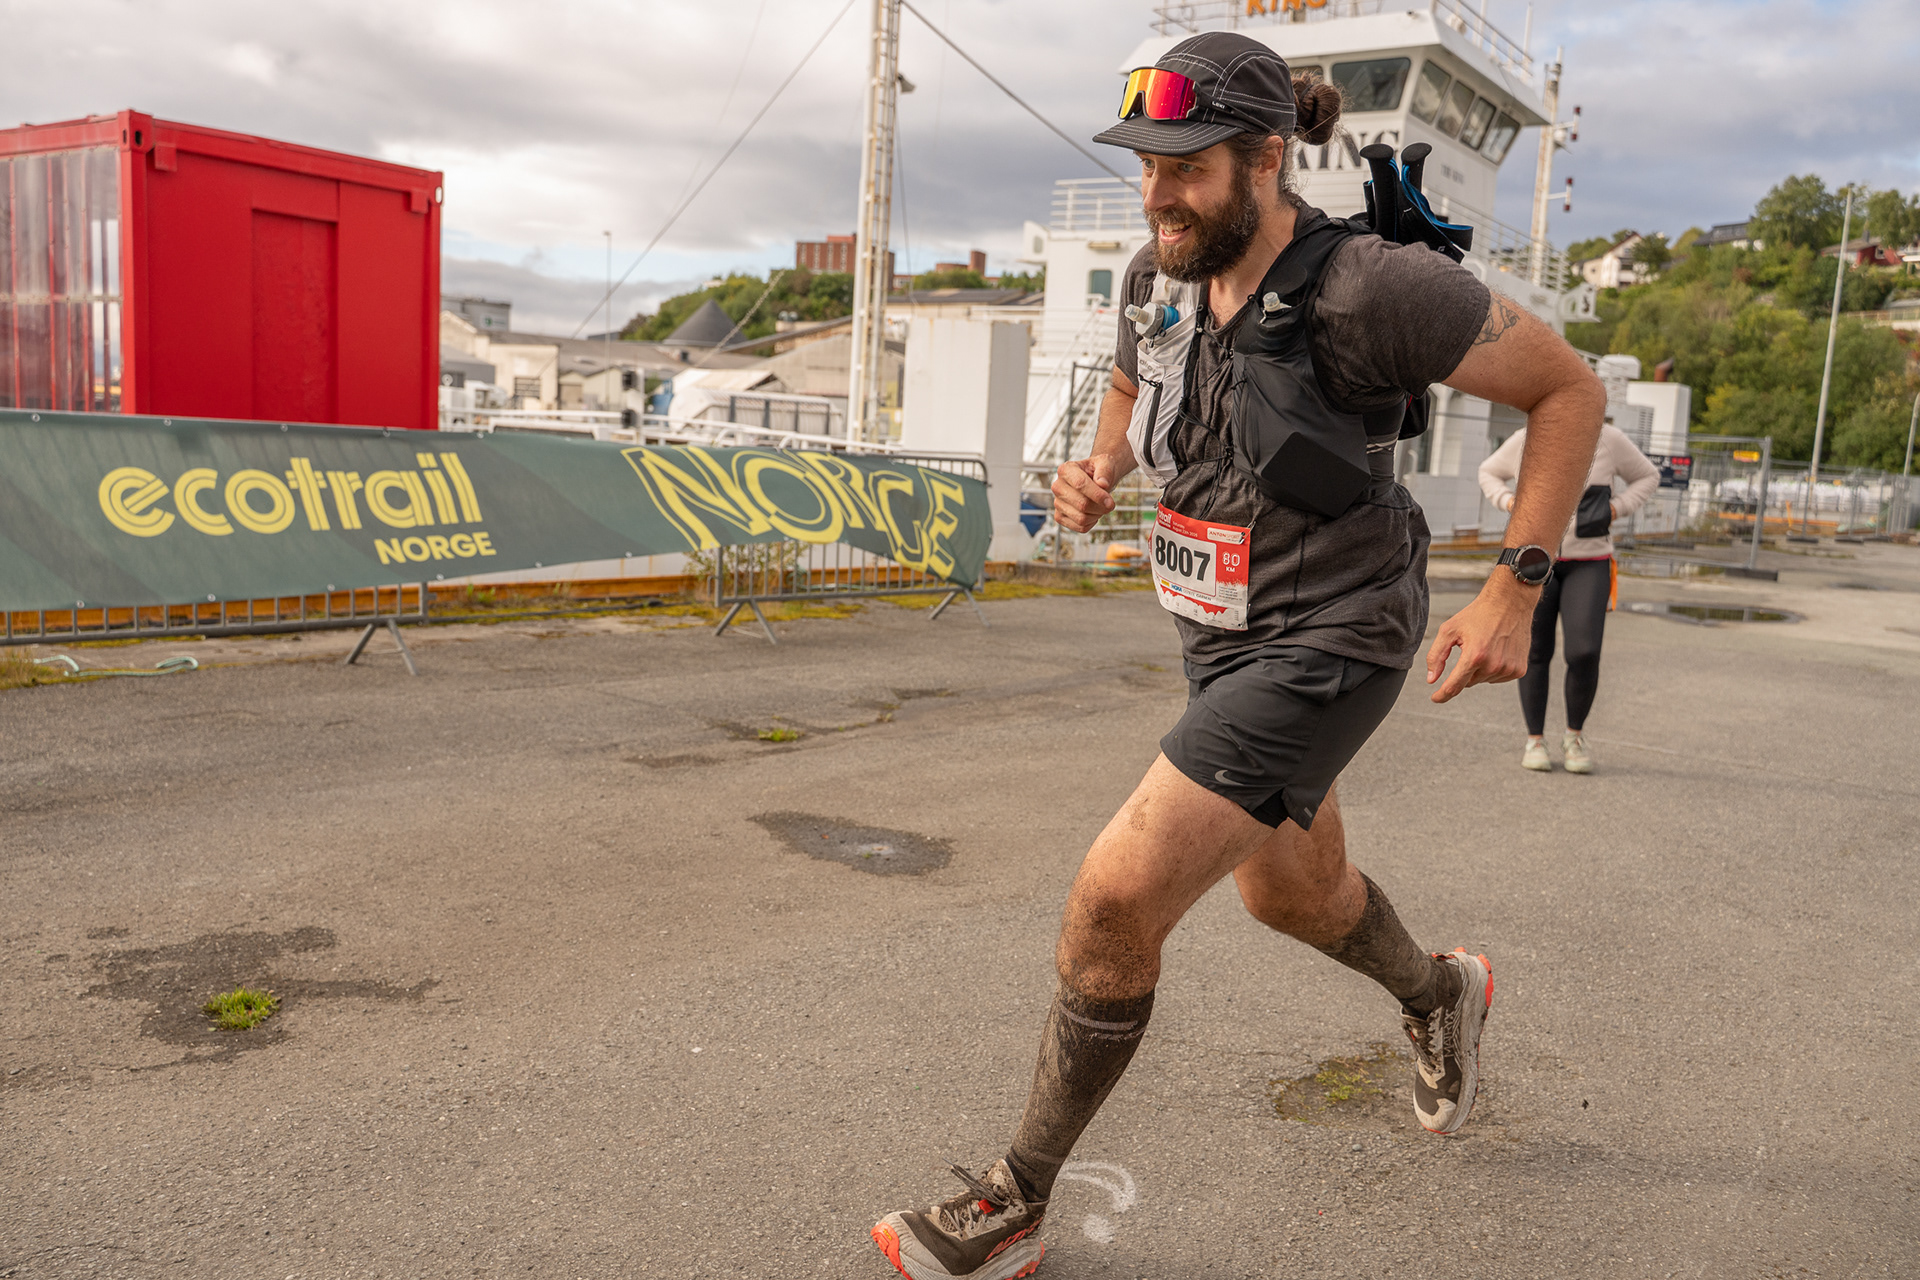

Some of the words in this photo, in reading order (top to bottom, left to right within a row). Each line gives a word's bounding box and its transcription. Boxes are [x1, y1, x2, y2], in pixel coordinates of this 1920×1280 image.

[98, 452, 483, 538] ecotrail
[620, 445, 965, 581] NORGE
[373, 532, 497, 565] NORGE
[1155, 534, 1211, 582] 8007
[1223, 551, 1240, 567] 80
